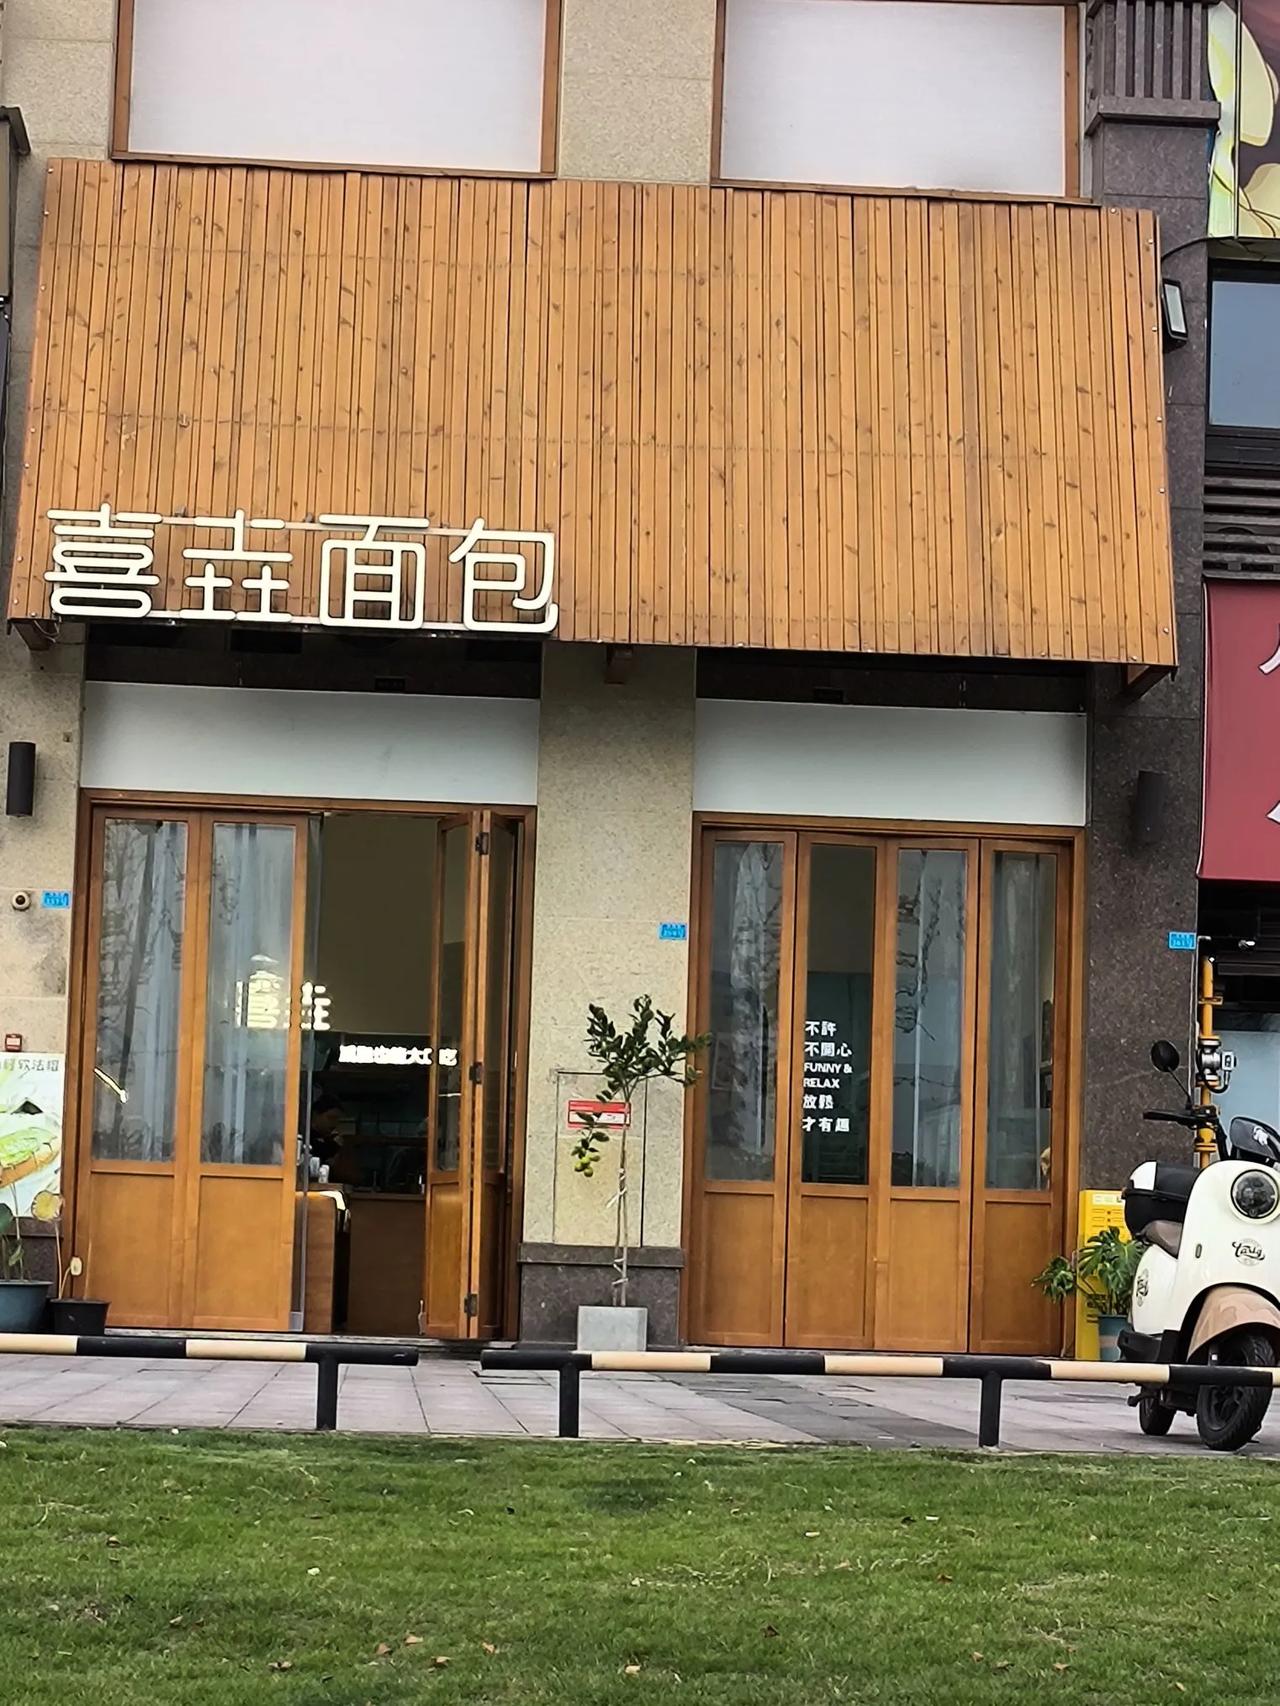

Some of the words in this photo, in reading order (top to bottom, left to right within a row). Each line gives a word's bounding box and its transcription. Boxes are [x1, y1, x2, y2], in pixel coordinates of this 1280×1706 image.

[44, 502, 559, 634] 喜垚面包
[805, 1021, 837, 1037] 不許
[803, 1062, 842, 1074] FUNNY
[843, 1063, 853, 1074] &
[803, 1078, 840, 1089] RELAX
